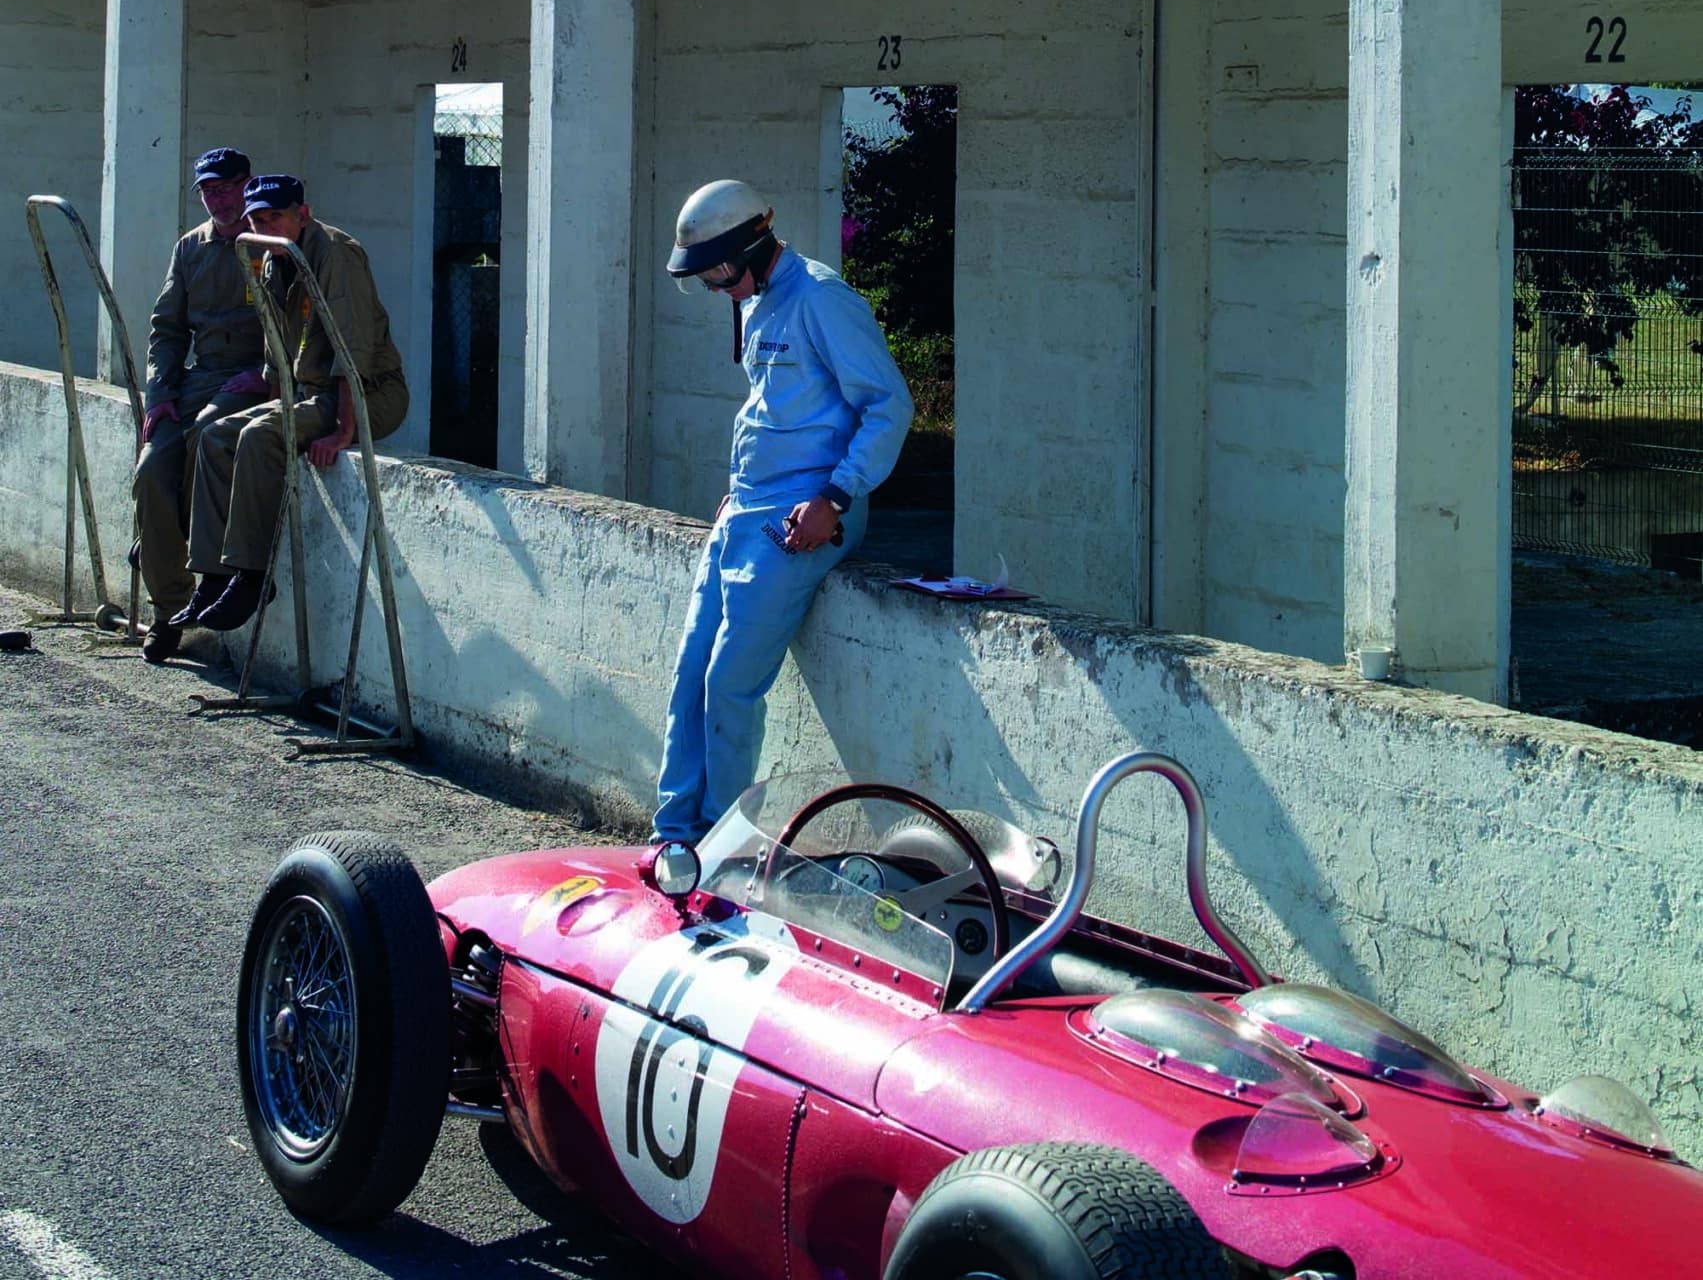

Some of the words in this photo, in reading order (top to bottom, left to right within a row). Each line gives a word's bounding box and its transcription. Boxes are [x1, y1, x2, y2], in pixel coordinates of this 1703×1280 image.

[877, 35, 902, 70] 23
[1585, 16, 1627, 63] 22
[451, 43, 467, 72] 24
[761, 522, 797, 556] DUNLOP
